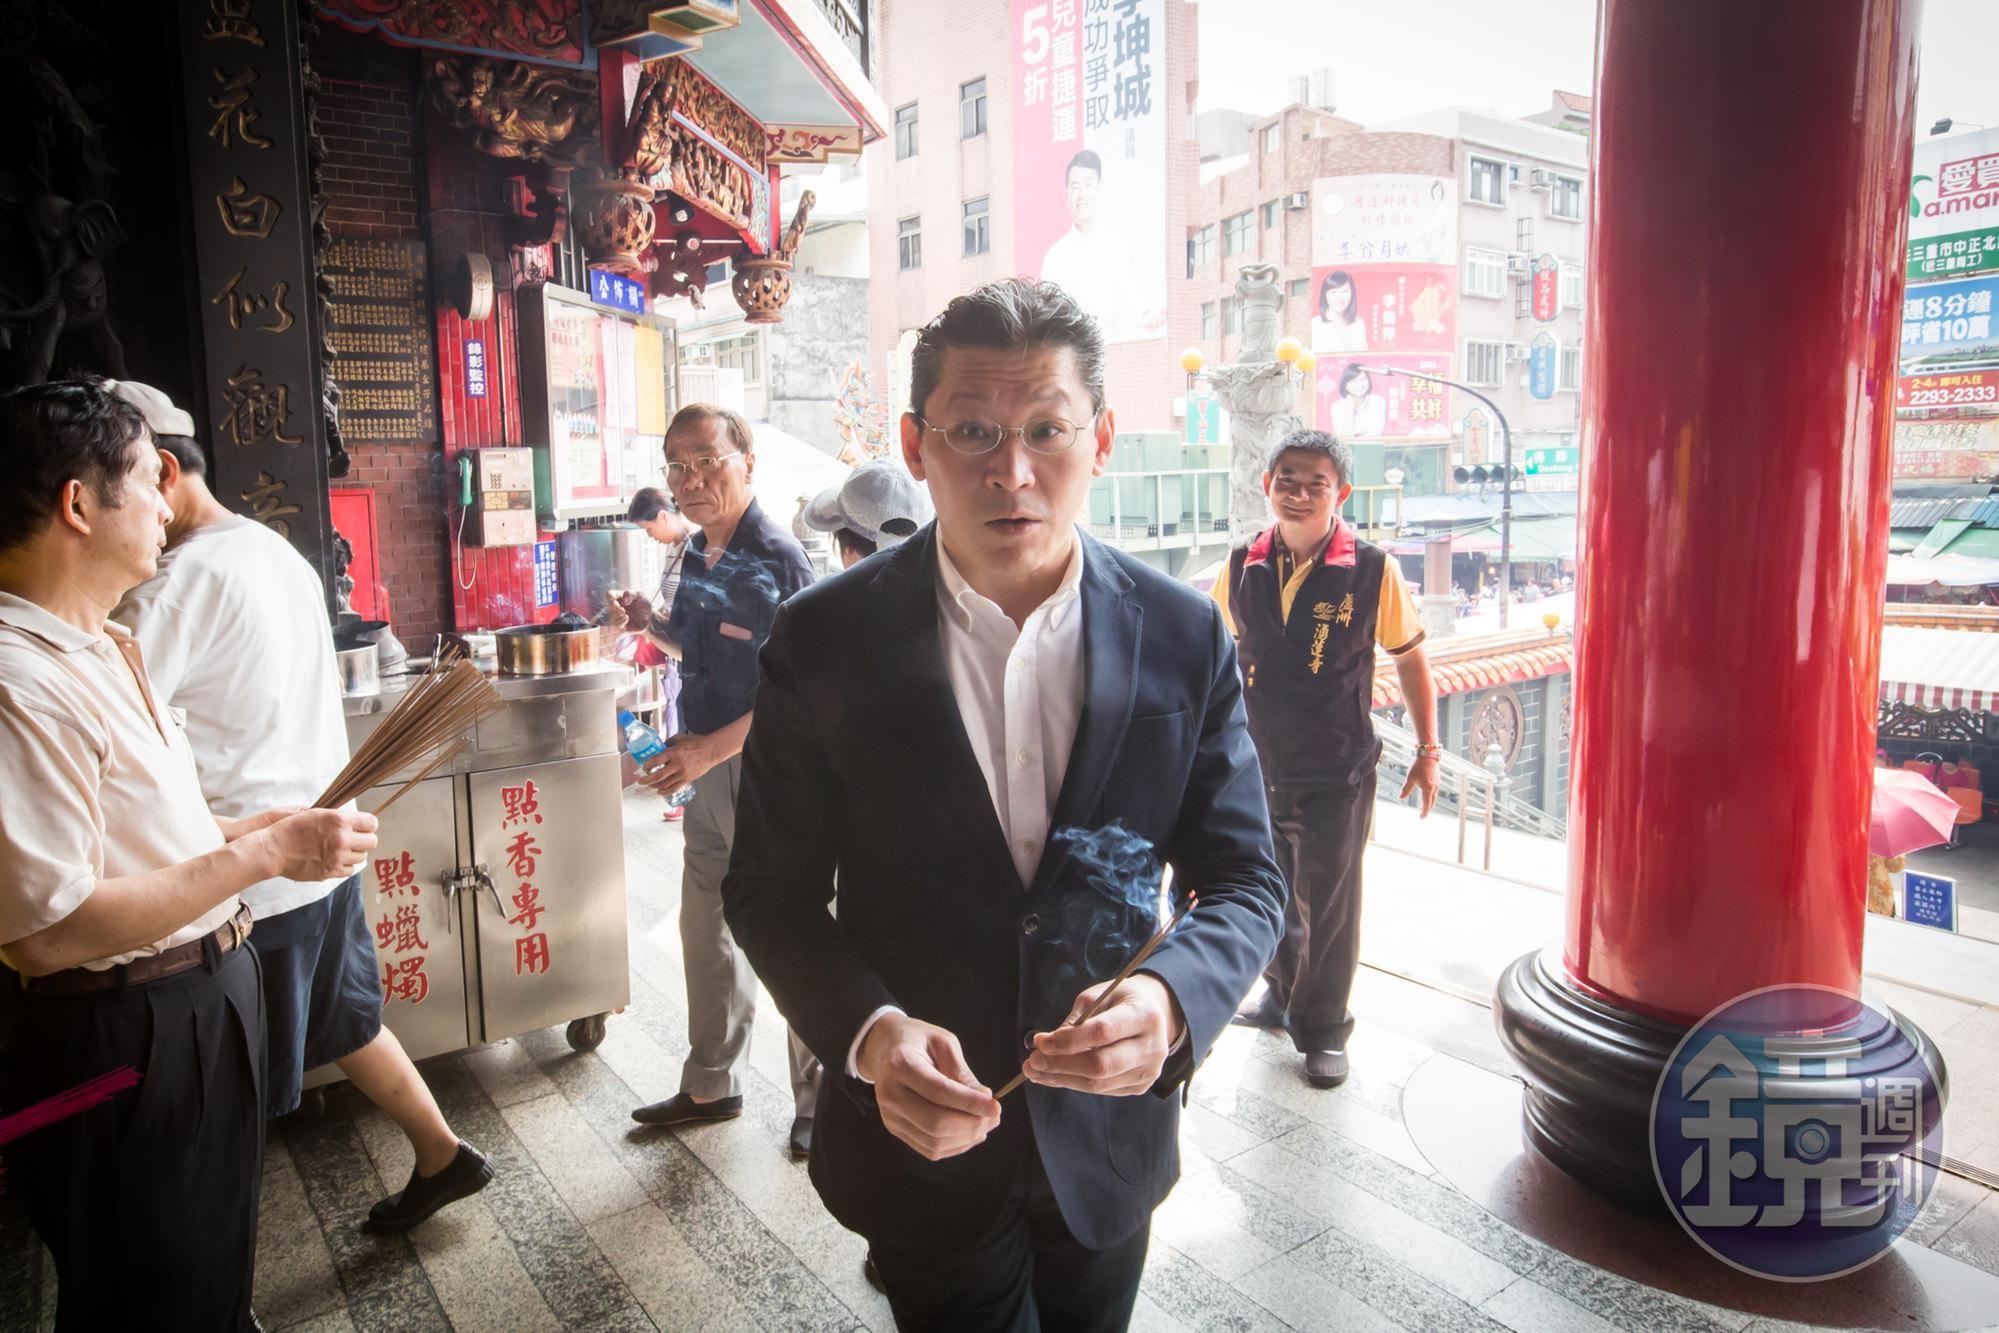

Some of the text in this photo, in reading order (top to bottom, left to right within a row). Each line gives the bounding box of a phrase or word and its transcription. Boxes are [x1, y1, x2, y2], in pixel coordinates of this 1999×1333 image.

[1022, 4, 1049, 107] 5折
[1051, 0, 1076, 144] 兒童捷運
[1907, 234, 1999, 263] 三重市中正北
[599, 274, 639, 309] 公佈欄
[467, 342, 485, 395] 錄影監控
[1910, 386, 1996, 405] 2293-2333
[500, 778, 551, 976] 點香專用
[374, 850, 429, 1008] 點蠟燭
